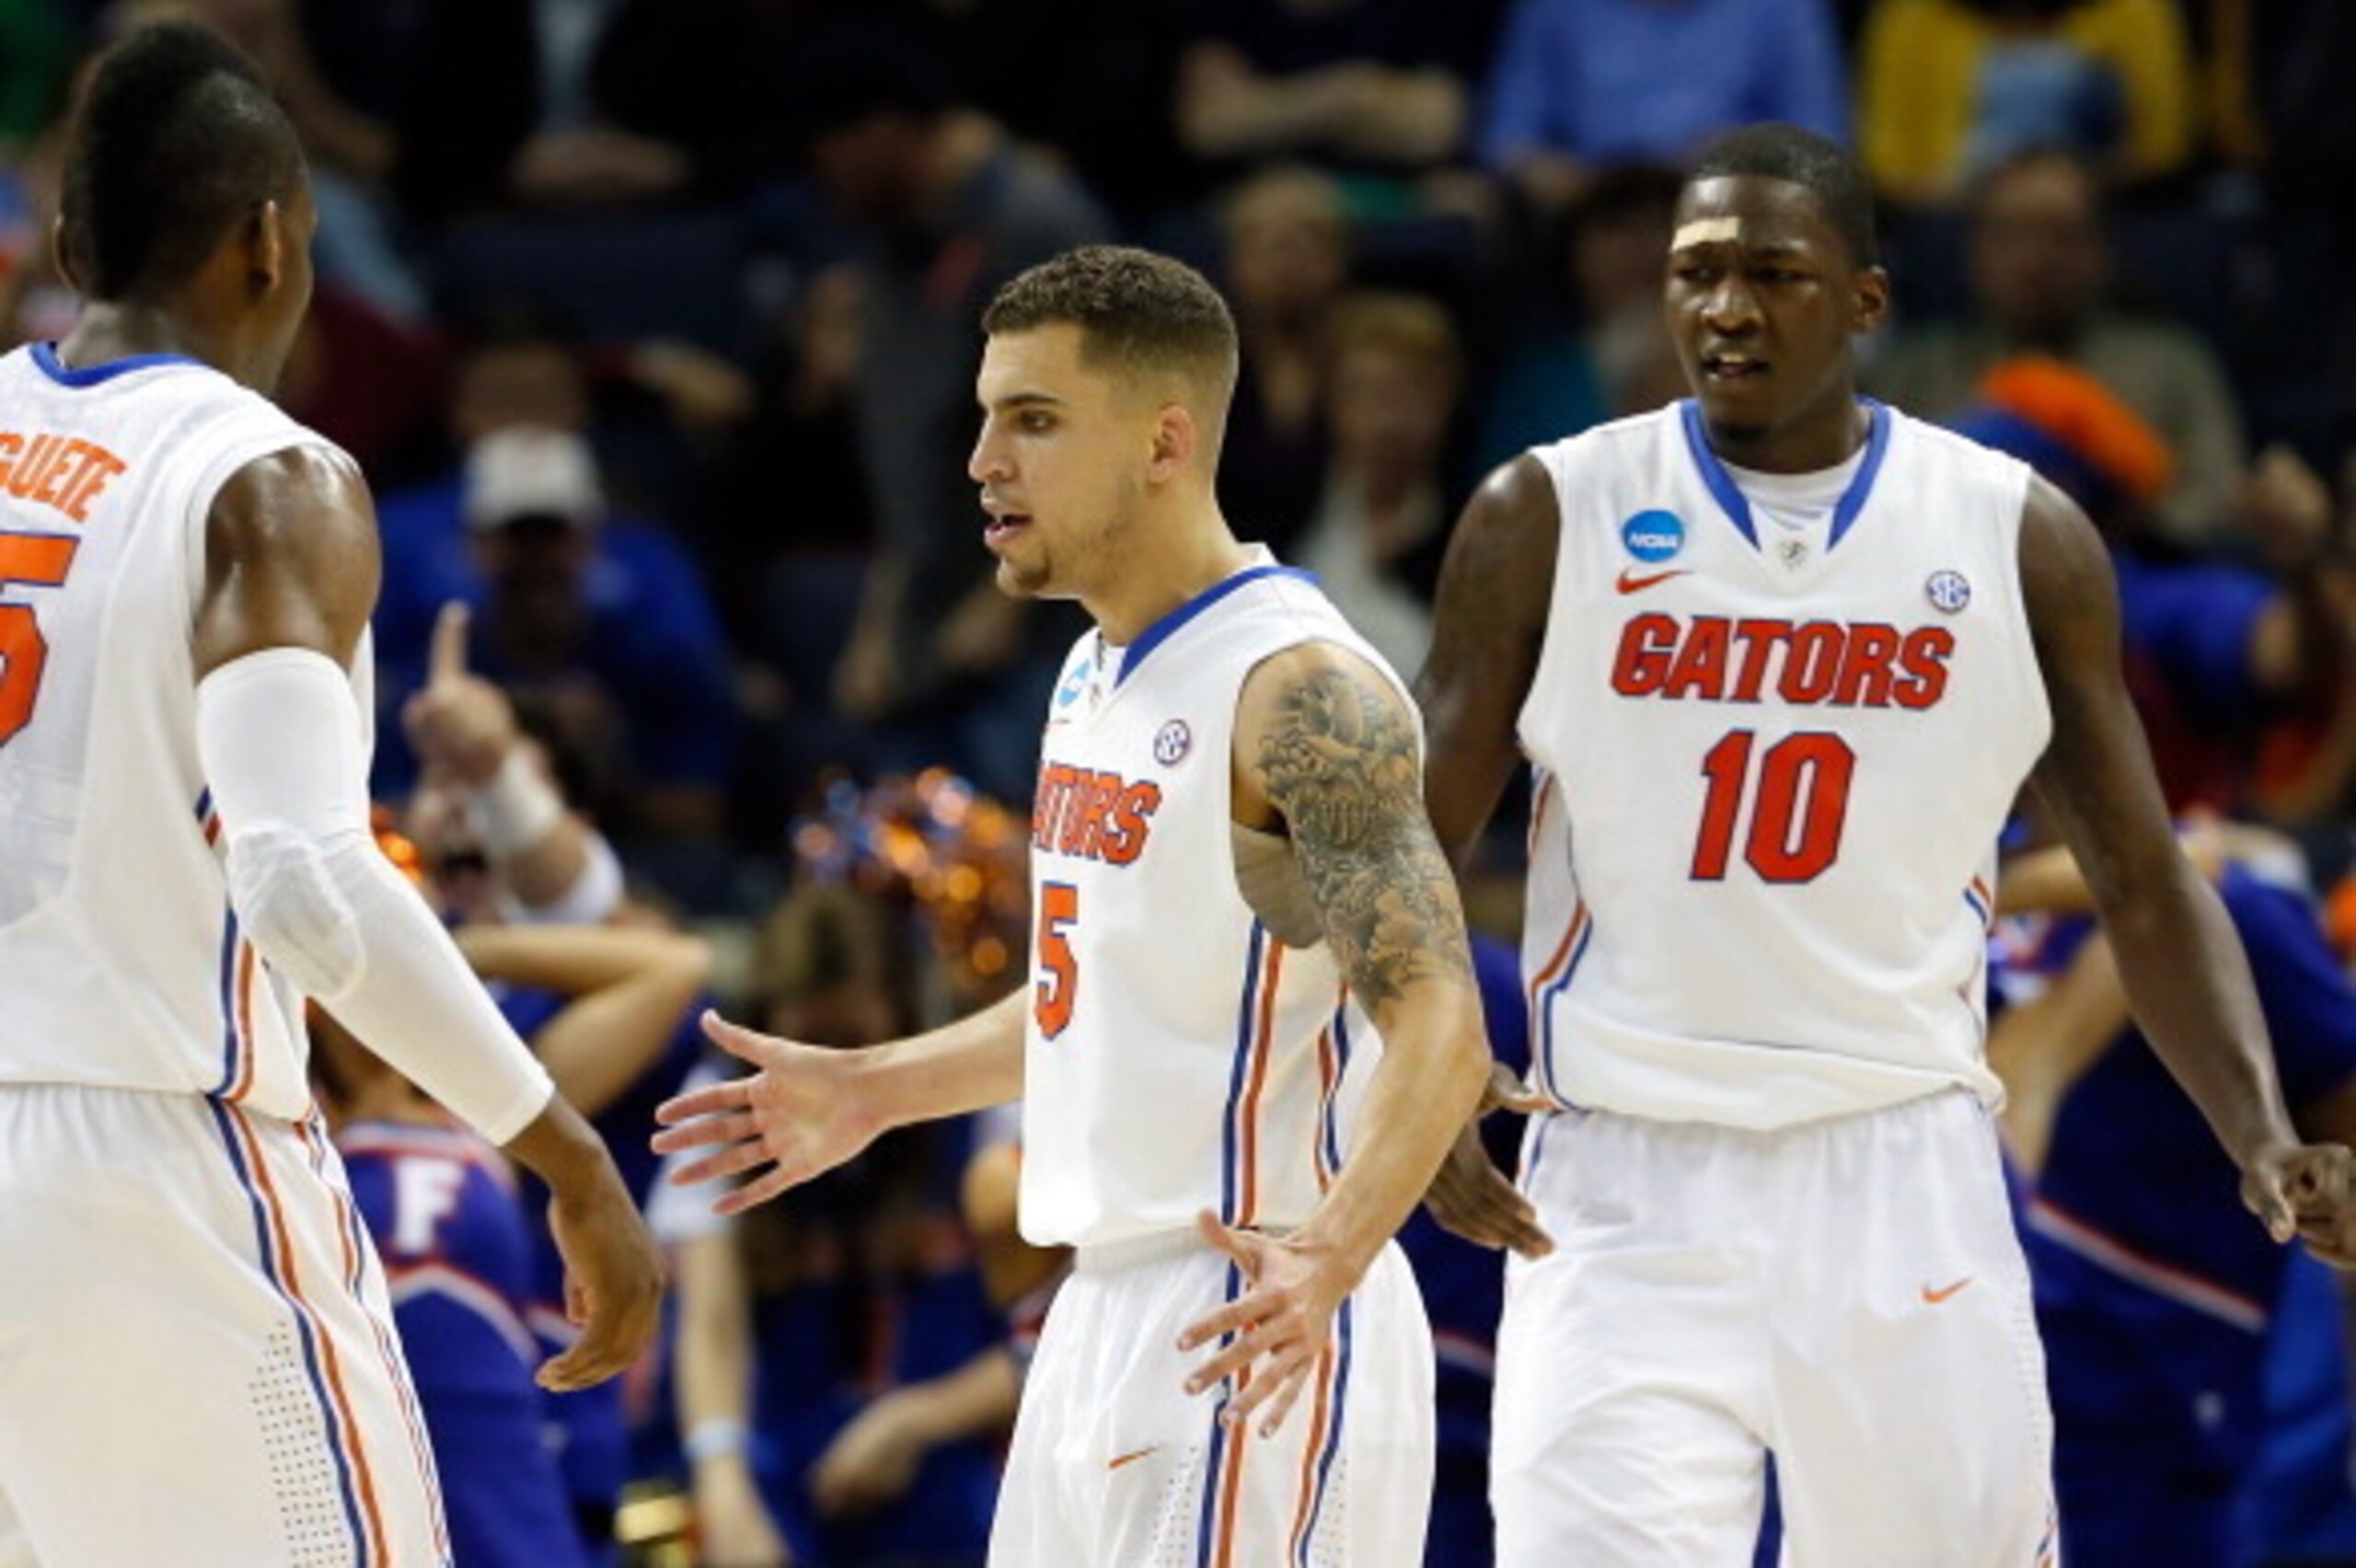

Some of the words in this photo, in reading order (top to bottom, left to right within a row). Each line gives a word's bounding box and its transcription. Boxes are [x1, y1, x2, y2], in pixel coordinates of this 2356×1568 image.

[1611, 612, 1956, 710] GATORS
[1689, 729, 1856, 884] 10
[1034, 881, 1078, 1041] 5
[396, 1155, 464, 1253] F
